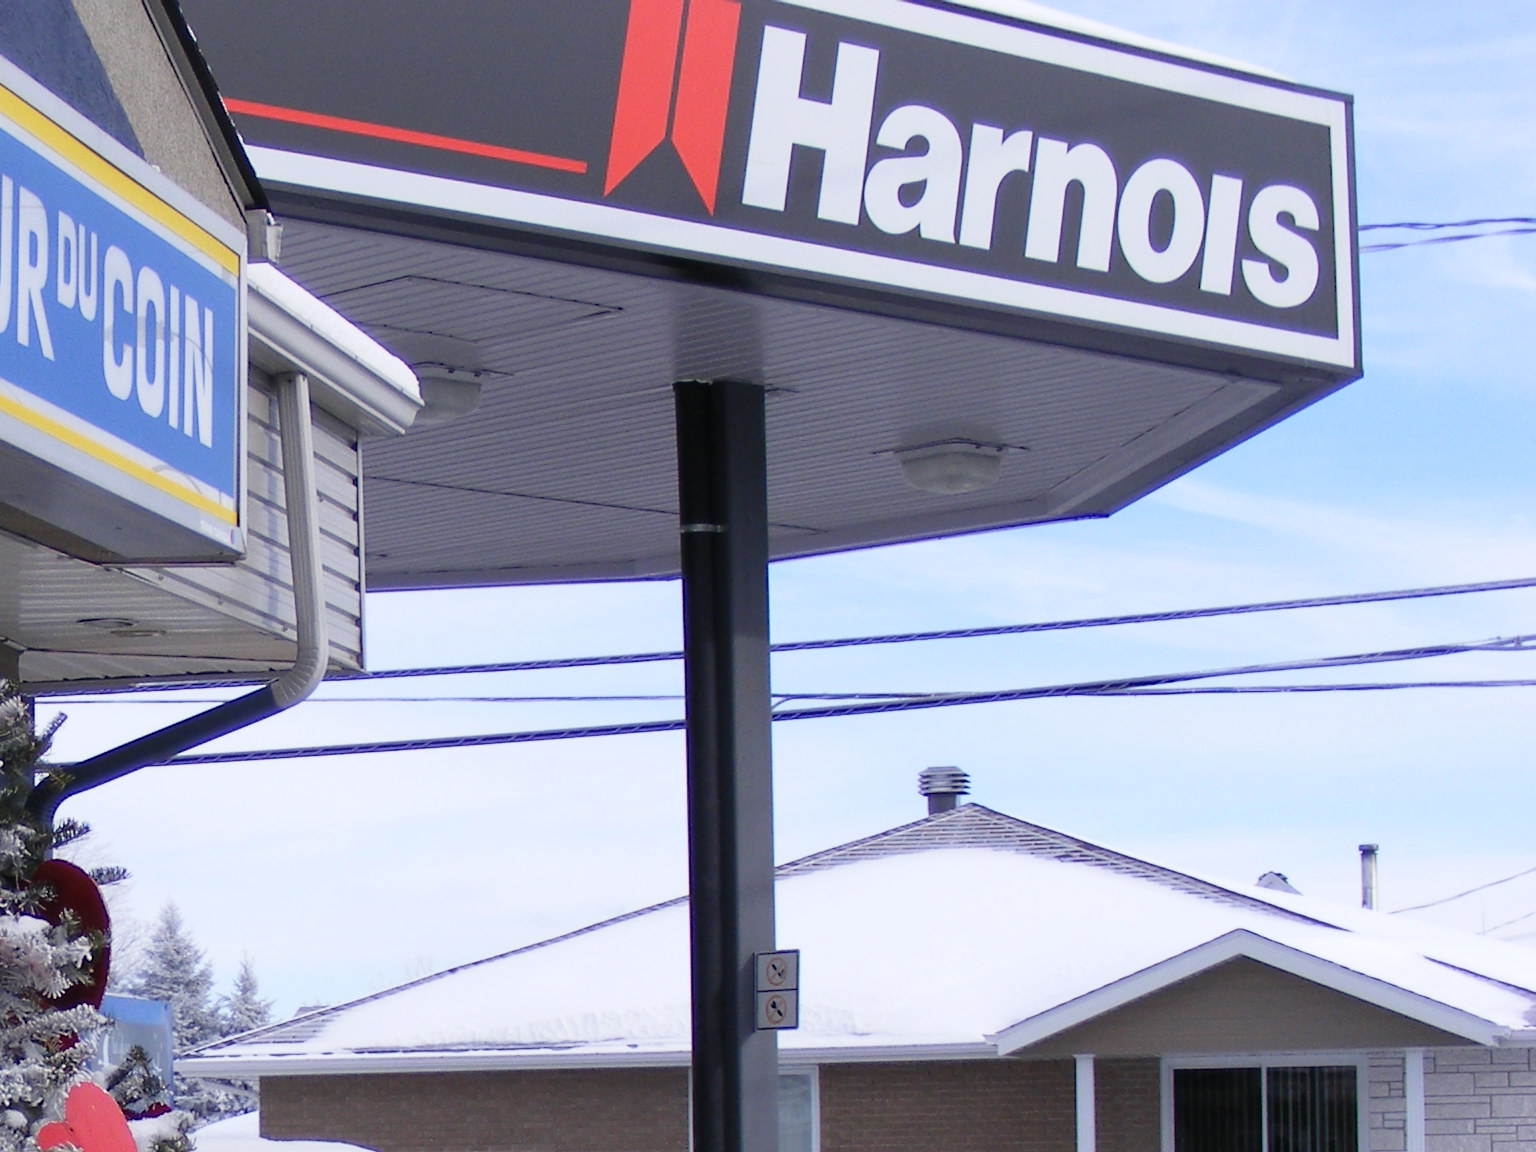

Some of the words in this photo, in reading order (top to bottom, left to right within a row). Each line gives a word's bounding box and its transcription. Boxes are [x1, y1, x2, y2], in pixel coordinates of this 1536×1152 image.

[741, 24, 1320, 309] Harnois
[57, 210, 98, 321] DU
[103, 244, 213, 449] COIN
